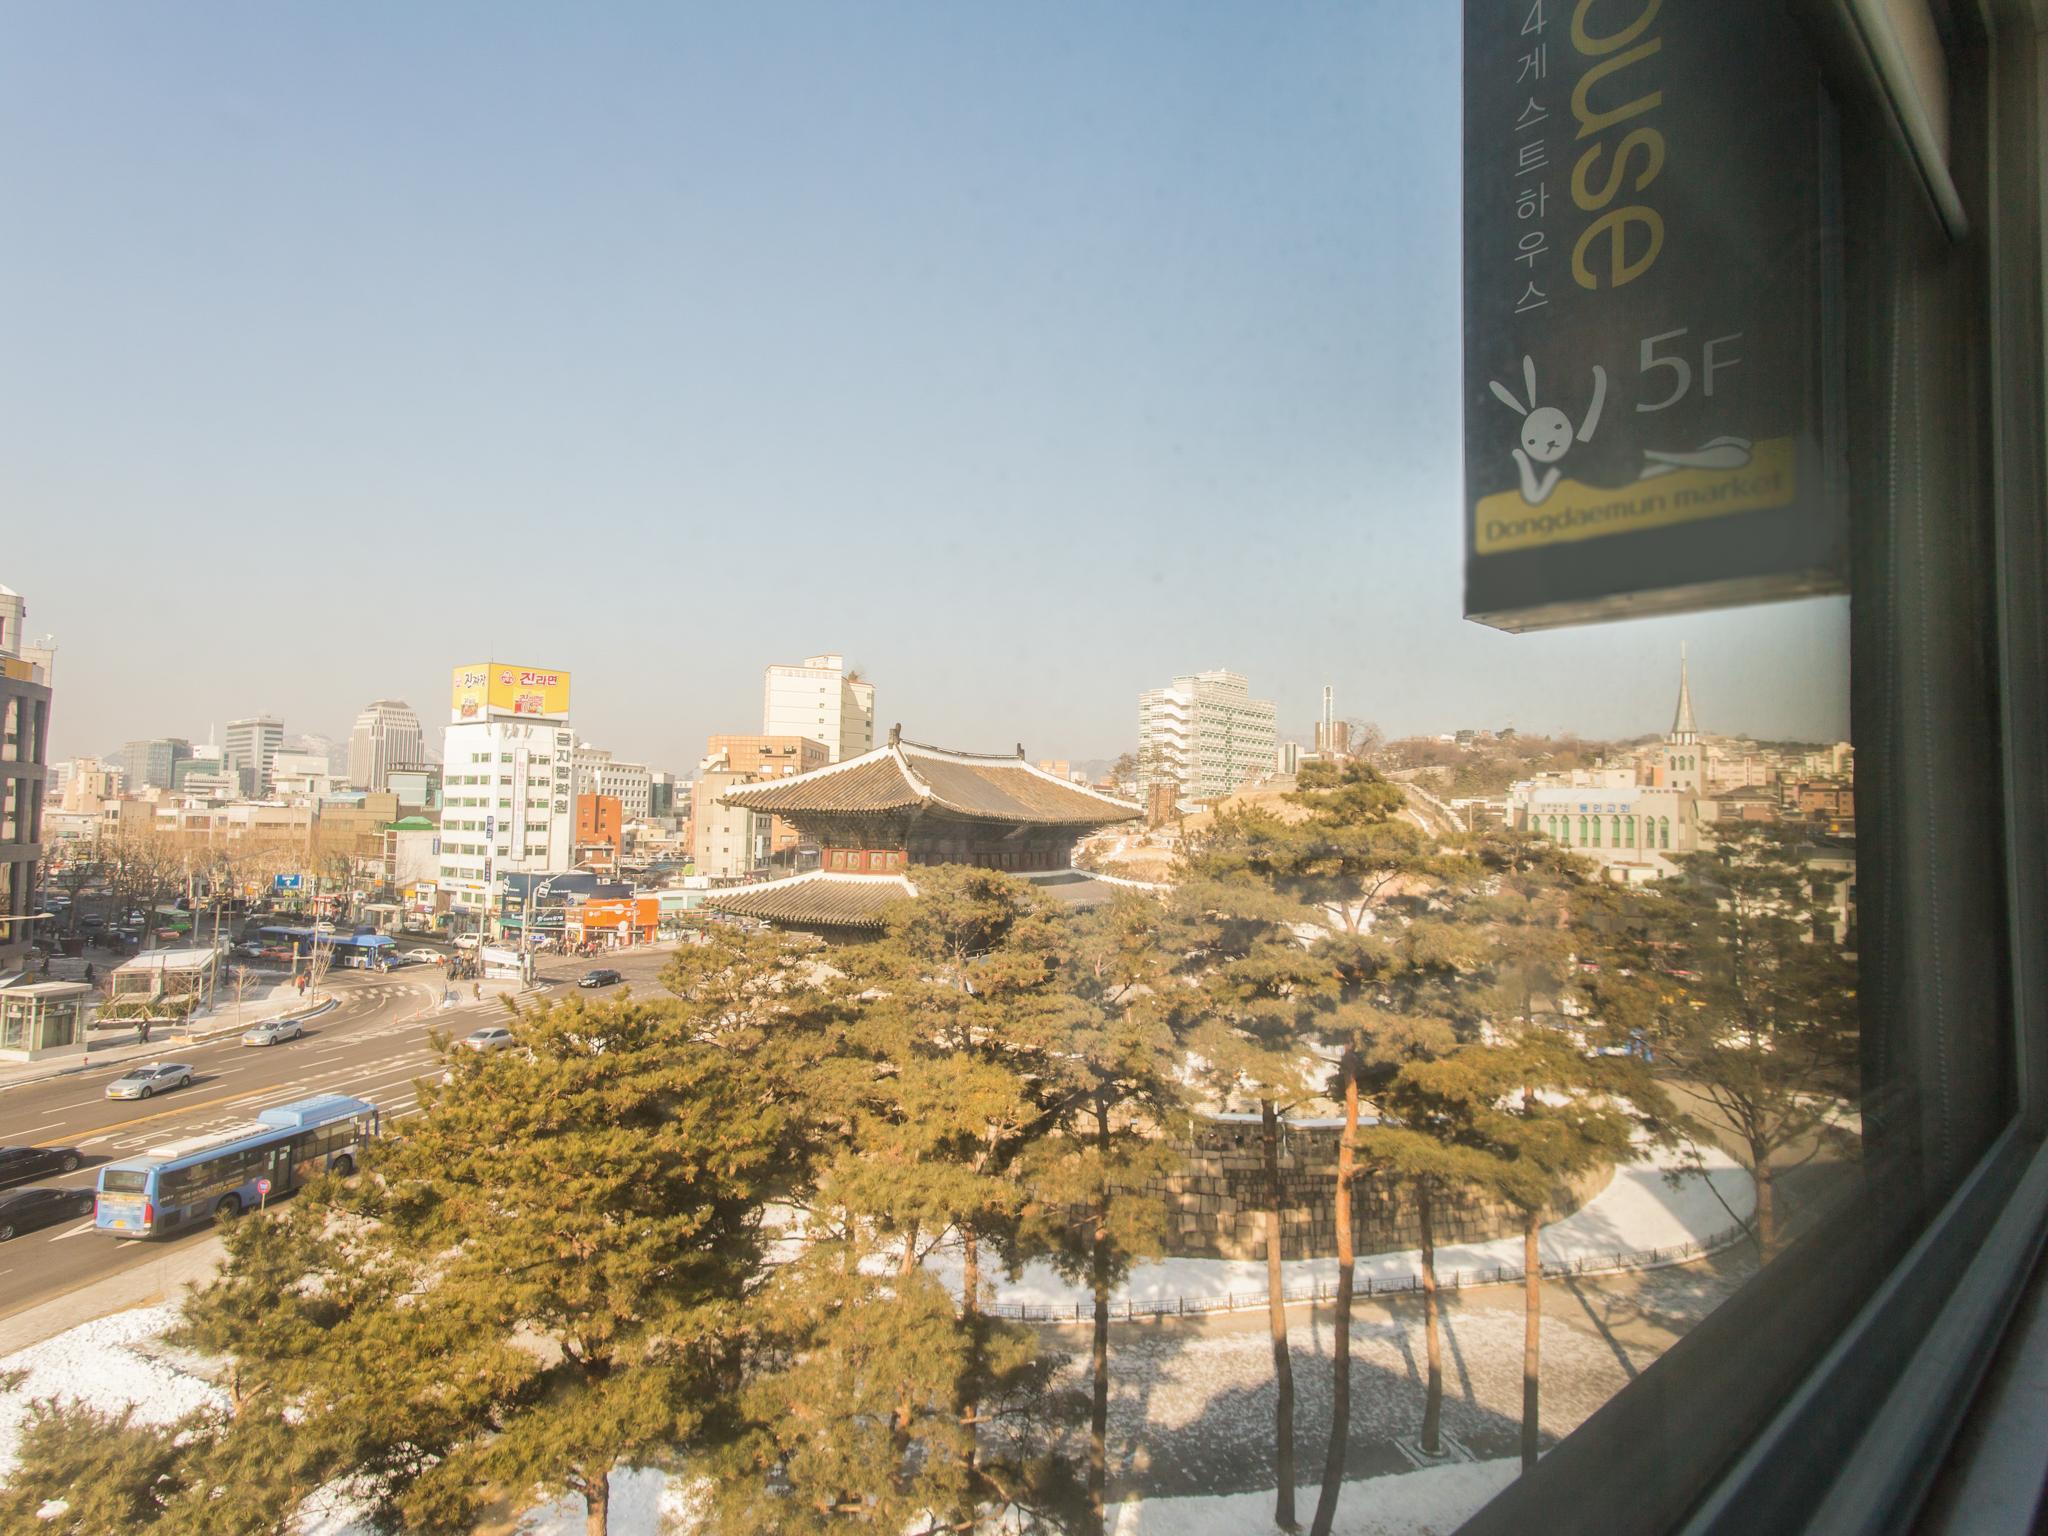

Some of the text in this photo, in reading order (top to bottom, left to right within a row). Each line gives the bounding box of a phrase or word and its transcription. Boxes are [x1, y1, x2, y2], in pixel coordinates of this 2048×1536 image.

[1636, 328, 1743, 412] 5F
[1485, 473, 1784, 542] Dongdaemun market
[520, 672, 558, 686] 진라면
